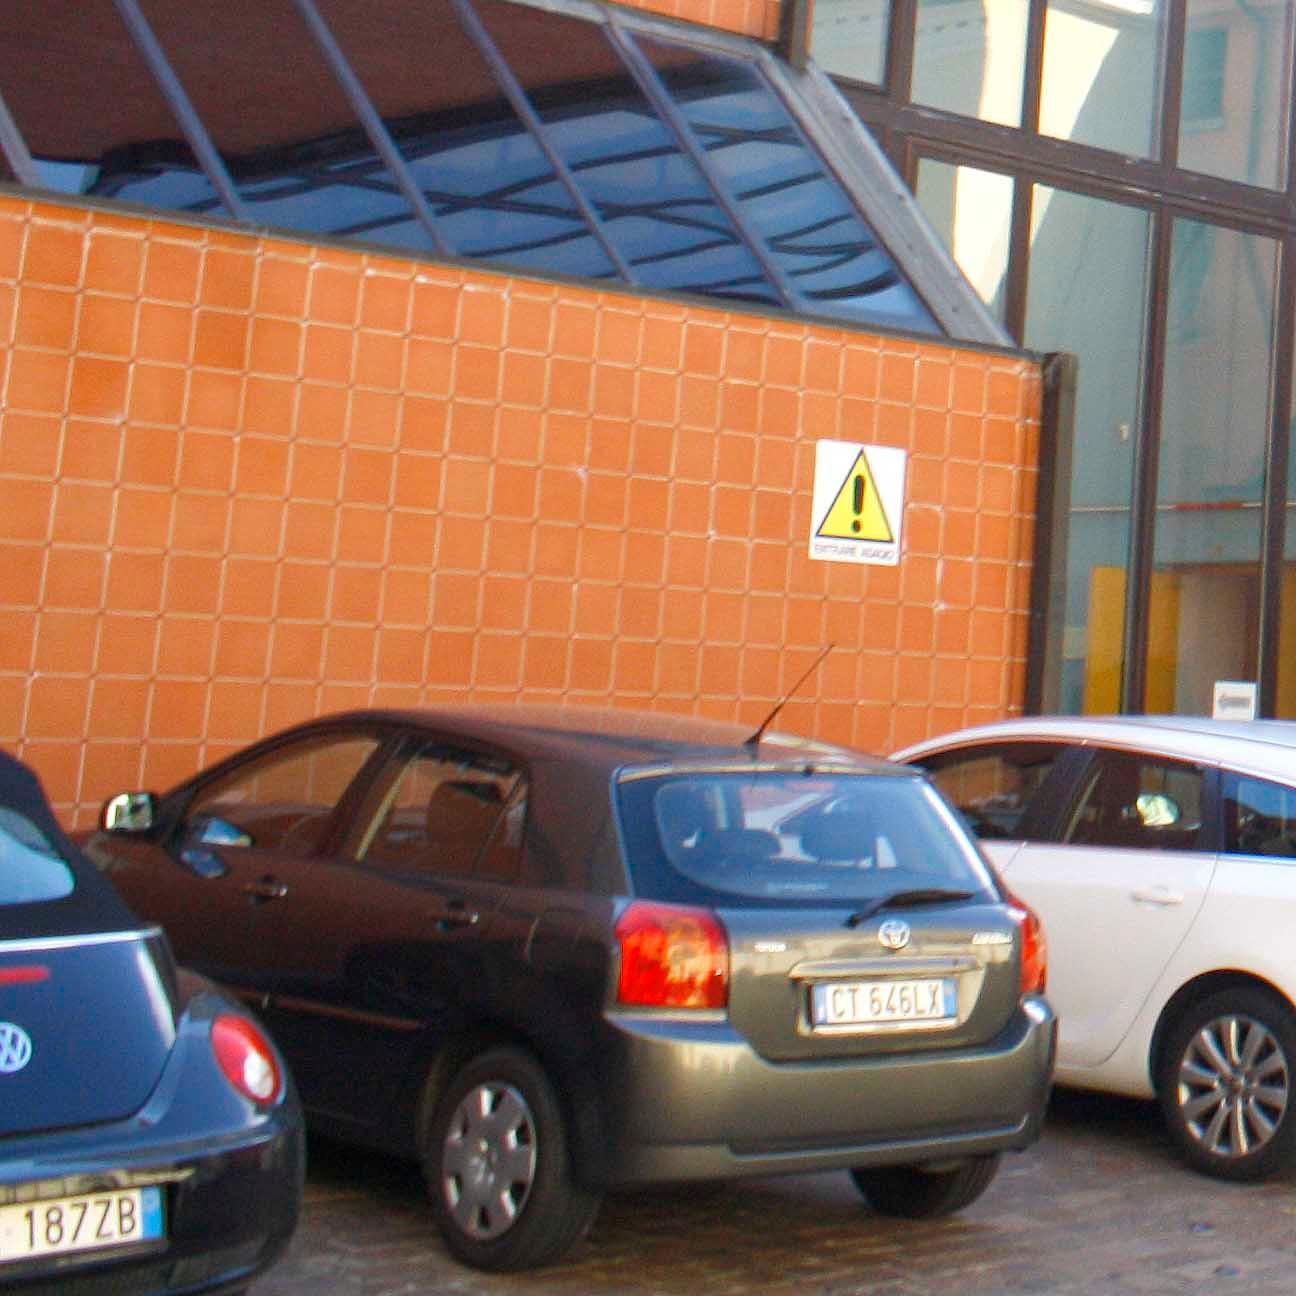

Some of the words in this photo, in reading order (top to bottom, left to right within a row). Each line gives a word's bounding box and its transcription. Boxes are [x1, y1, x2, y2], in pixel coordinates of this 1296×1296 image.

[831, 986, 860, 1019] CT
[869, 982, 941, 1018] 646LX
[24, 1196, 137, 1250] 187ZB
